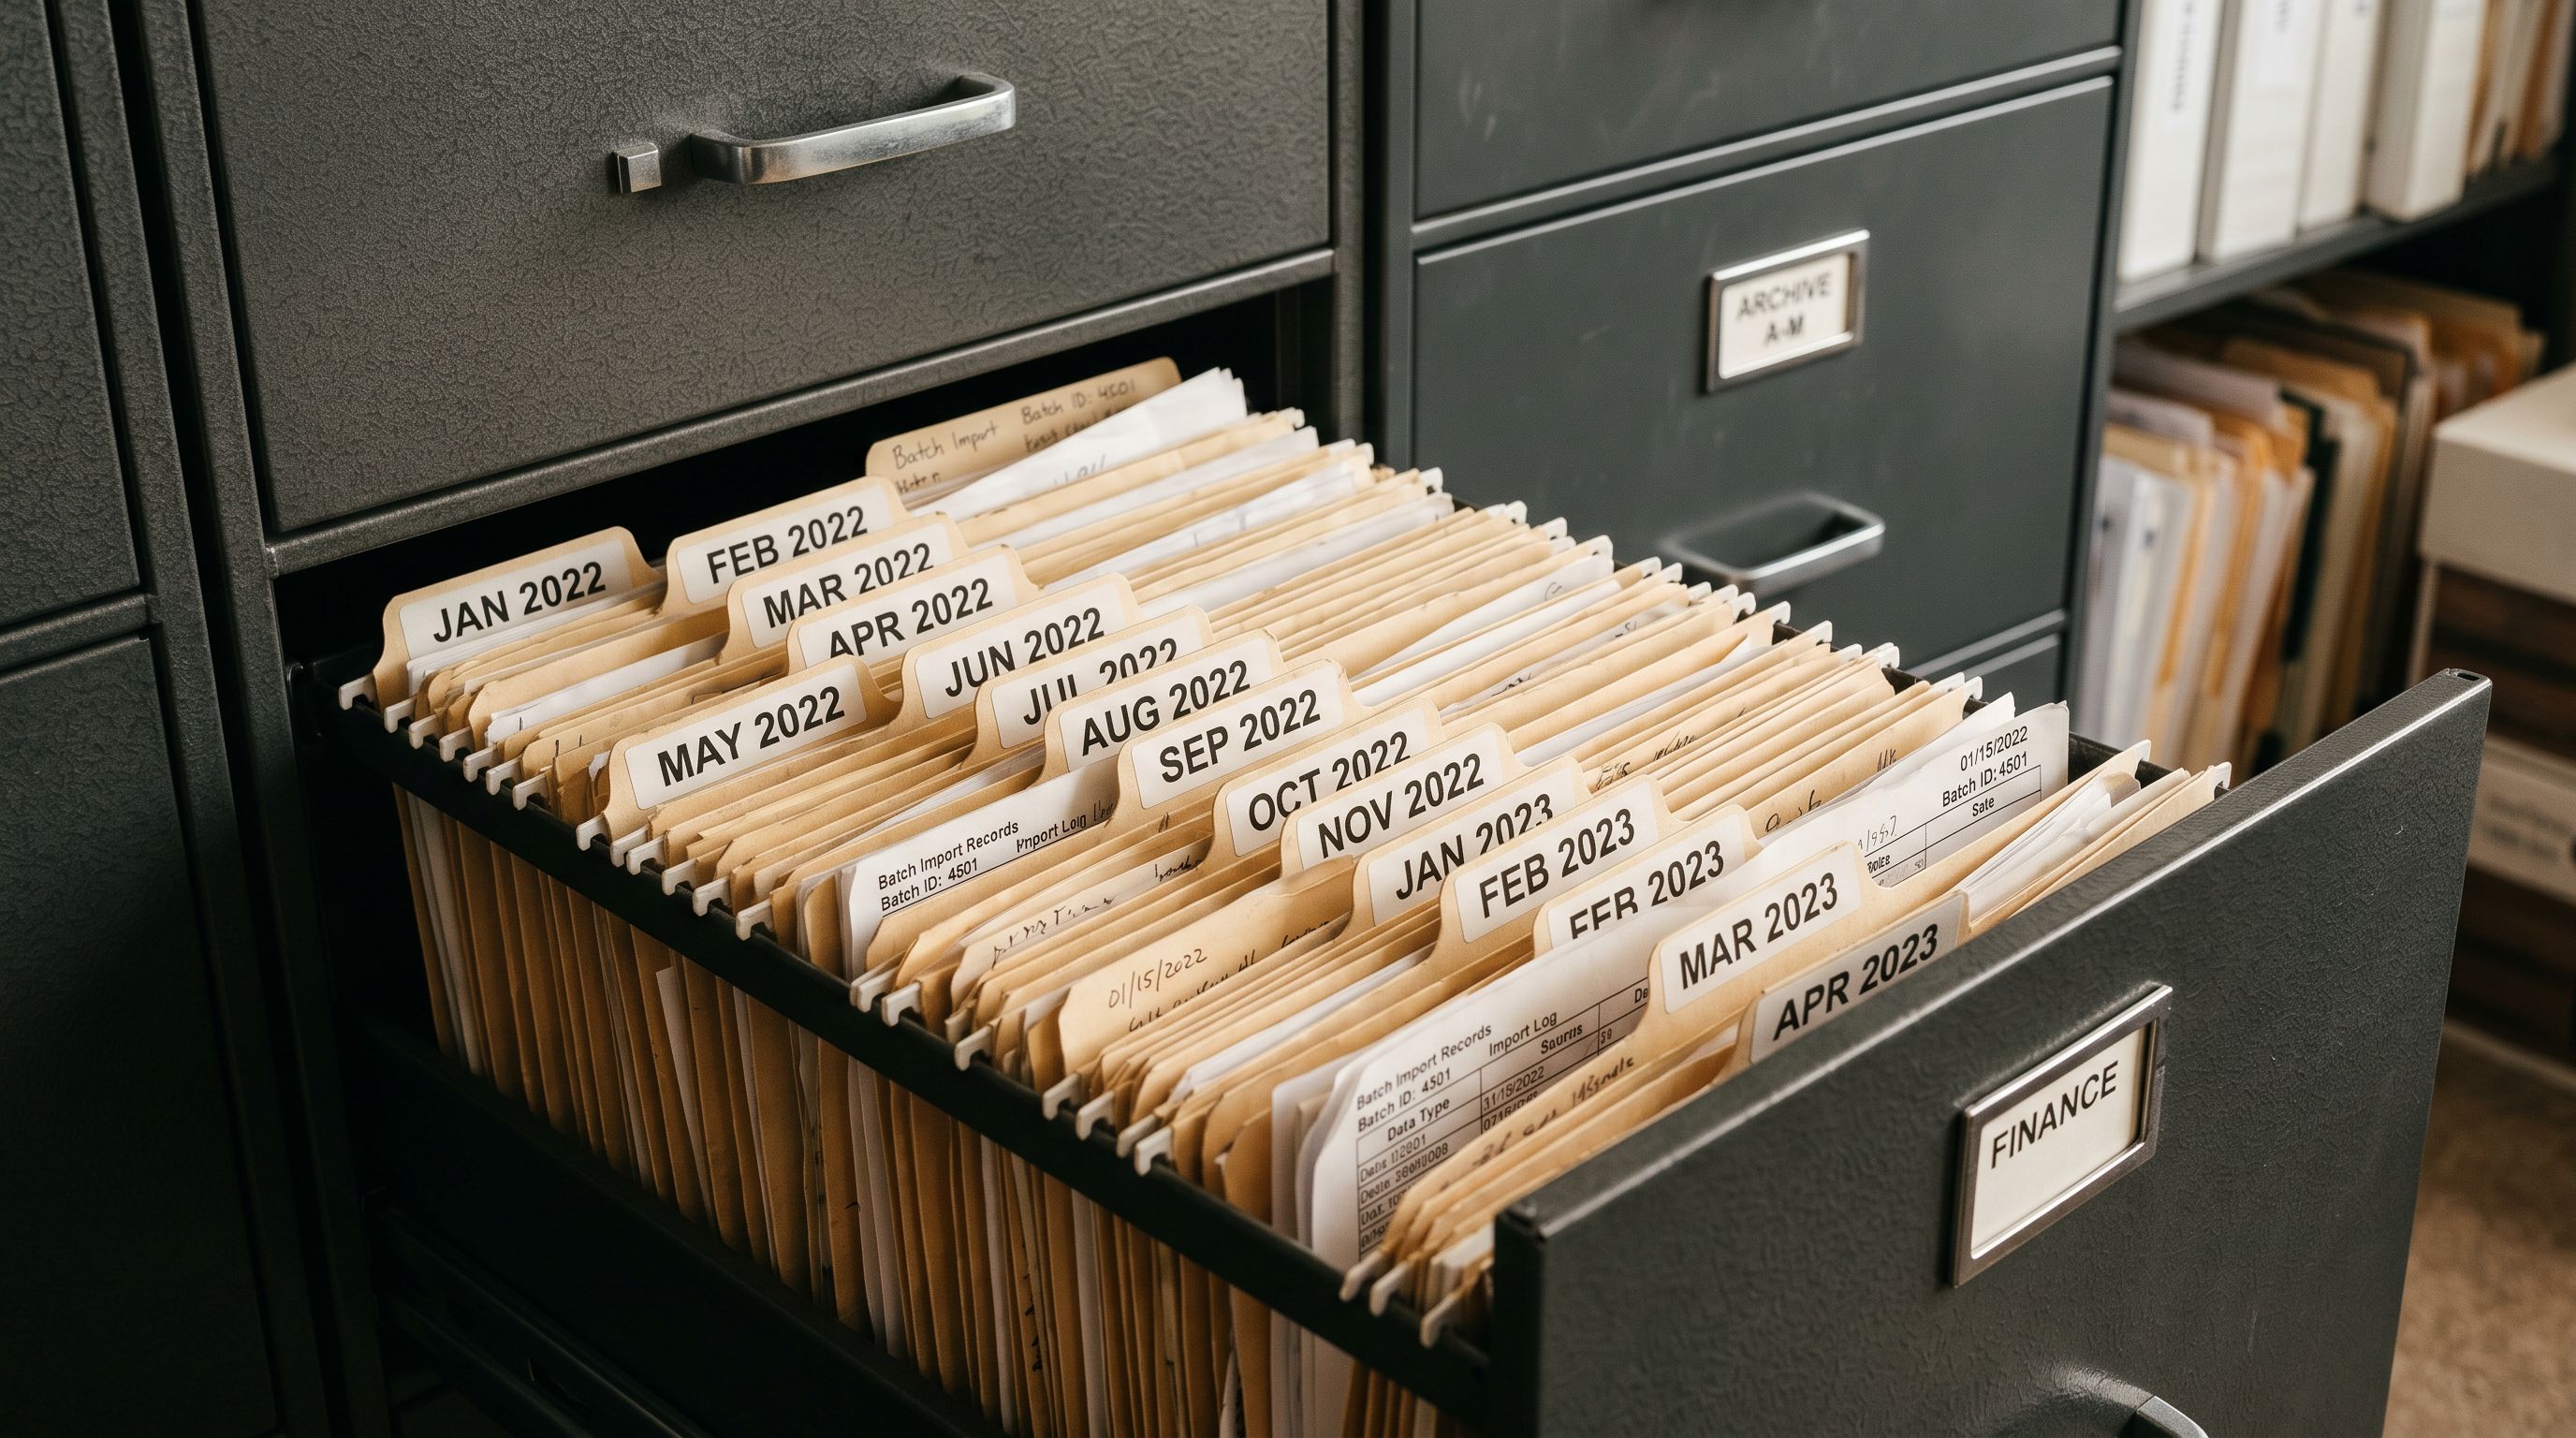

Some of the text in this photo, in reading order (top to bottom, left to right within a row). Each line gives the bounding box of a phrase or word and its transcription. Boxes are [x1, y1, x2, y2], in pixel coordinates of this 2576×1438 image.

[1736, 271, 1832, 320] ARCHIVE
[1764, 315, 1804, 345] A-M
[892, 437, 944, 470] Batch
[952, 421, 999, 452] Import
[1021, 401, 1064, 426] Batch
[708, 506, 867, 584] FEB 2022
[433, 562, 607, 642] JAN 2022
[764, 544, 932, 628] MAR 2022
[831, 579, 992, 658] APR 2022
[945, 609, 1104, 697] JUN 2022
[1100, 638, 1176, 684] 2022
[658, 686, 844, 786] MAY 2022
[1083, 660, 1251, 756] AUG 2022
[1161, 690, 1320, 783] SEP 2022
[1250, 732, 1410, 830] OCT 2022
[1942, 751, 2028, 807] Batch ID: 4501
[1960, 726, 2028, 771] 01/15/2022
[1319, 754, 1485, 858] NOV 2022
[1972, 797, 1995, 817] Sate
[878, 821, 1019, 890] Batch Import Records
[881, 857, 978, 911] Batch ID: 4501
[1397, 793, 1553, 900] JAN 2023
[1480, 809, 1633, 918] FEB 2023
[1648, 841, 1723, 906] 2023
[1681, 873, 1837, 989] MAR 2023
[1108, 948, 1208, 1010] 01/15/2022
[1773, 924, 1938, 1041] APR 2023
[1356, 1023, 1492, 1110] Batch Import Records
[1489, 1012, 1558, 1057] Import Log
[1357, 1067, 1452, 1133] Batch ID: 4501
[1387, 1097, 1451, 1142] Data Type
[1992, 1061, 2117, 1167] FINANCE
